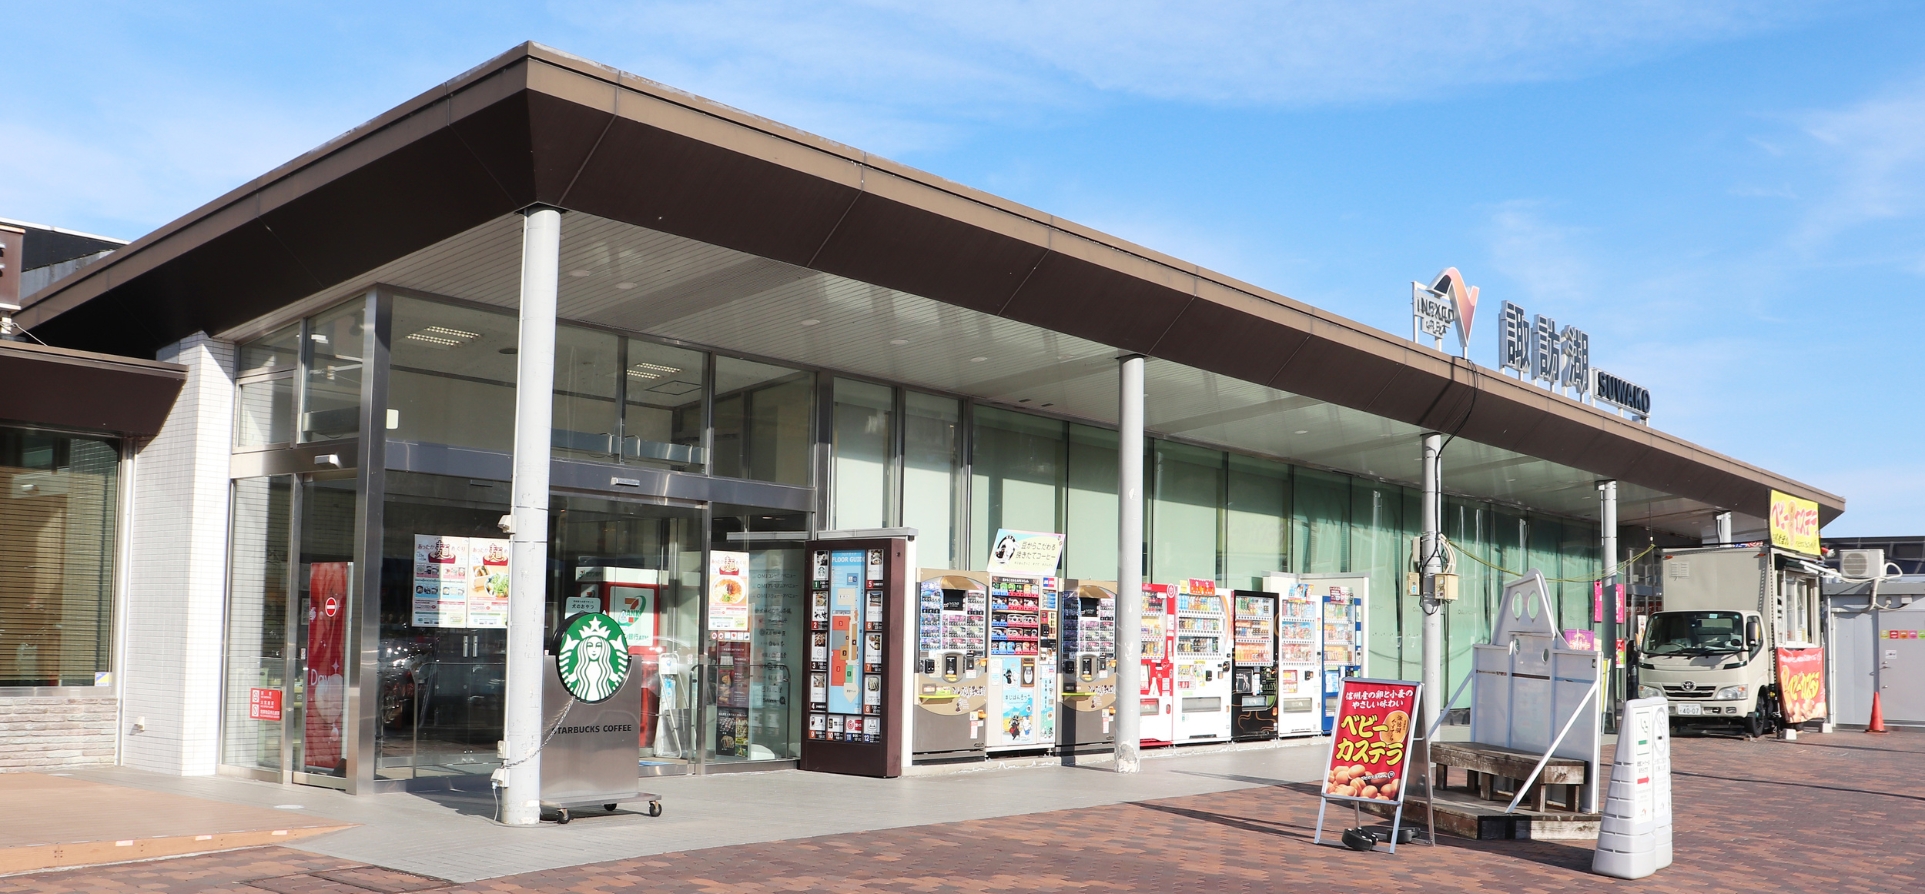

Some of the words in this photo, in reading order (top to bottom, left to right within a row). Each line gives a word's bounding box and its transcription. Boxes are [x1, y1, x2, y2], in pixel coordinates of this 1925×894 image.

[1502, 300, 1590, 393] 諏訪湖
[1598, 371, 1650, 413] SUWAKO
[1021, 541, 1056, 551] 豆からこだわる
[1346, 689, 1414, 700] 信州産の卵と小麦の
[1351, 700, 1404, 709] やさしい味わい
[551, 725, 600, 735] STARBUCKS
[602, 724, 632, 733] COFFEE
[1341, 714, 1389, 738] ベビー
[1335, 738, 1404, 766] カステラ
